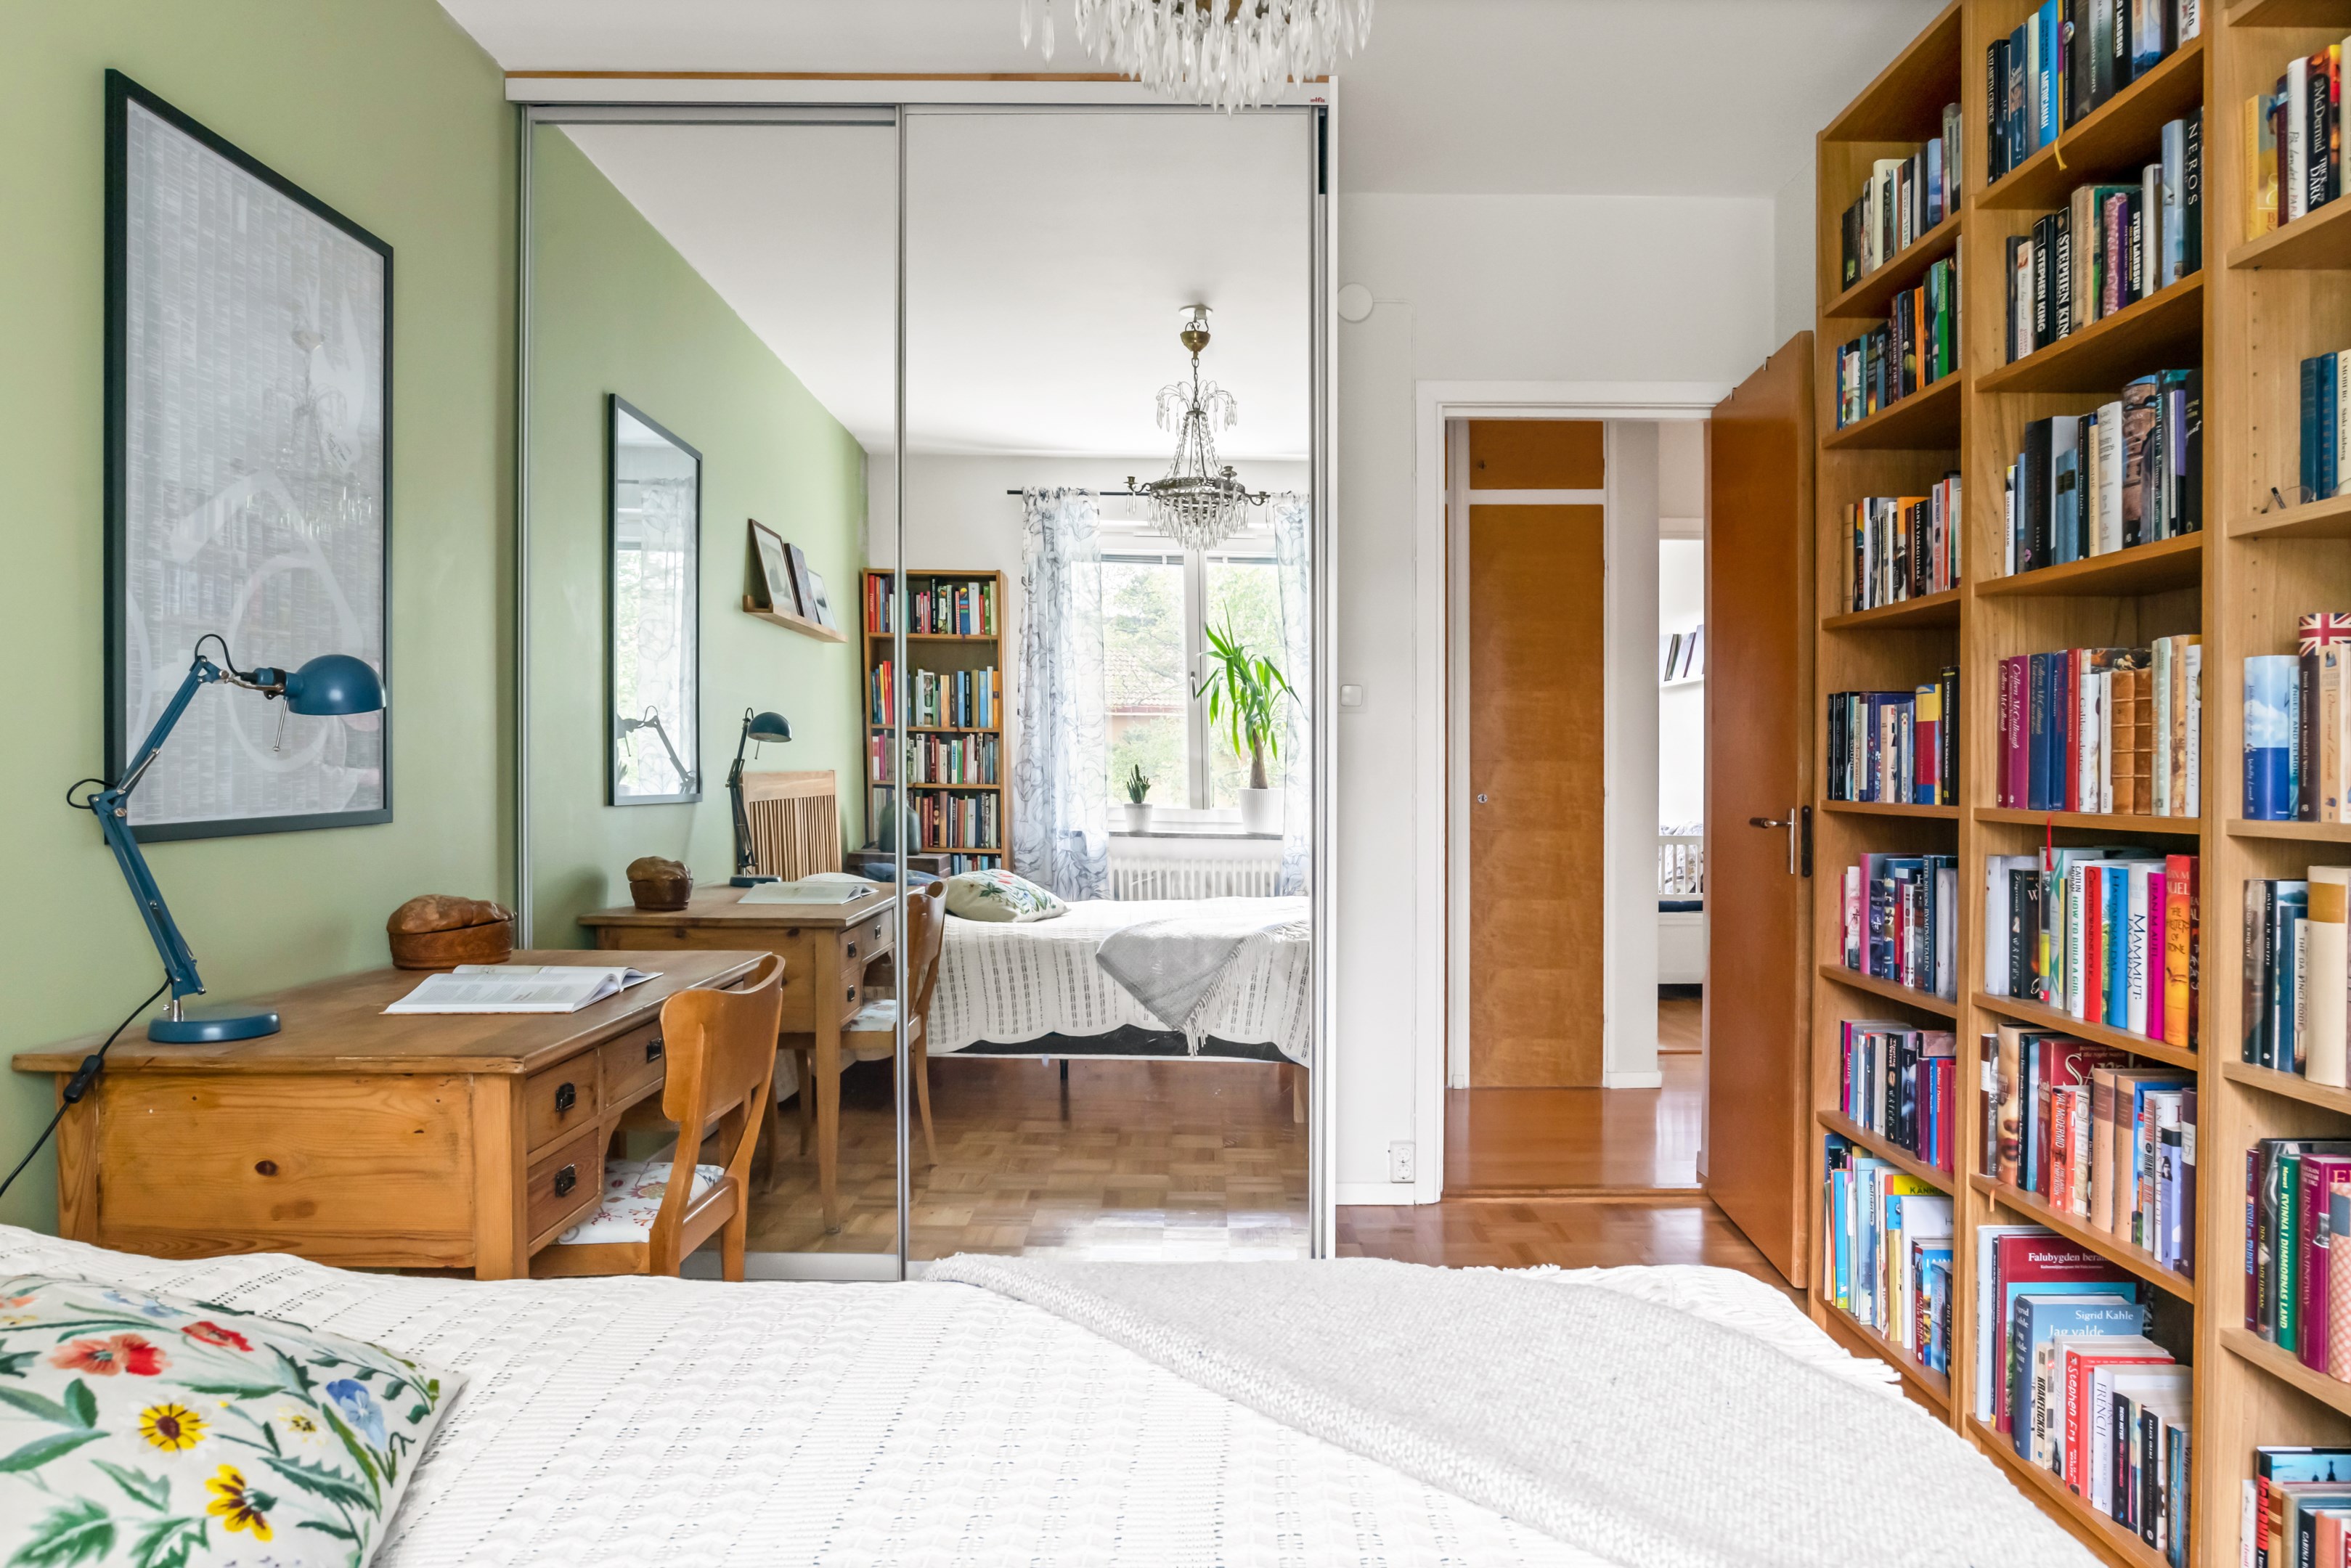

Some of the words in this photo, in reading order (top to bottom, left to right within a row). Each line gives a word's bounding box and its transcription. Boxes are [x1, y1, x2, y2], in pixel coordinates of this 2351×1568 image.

[2040, 70, 2049, 129] AMERICANAH
[2288, 131, 2300, 144] På
[2313, 90, 2326, 154] McDermid
[2318, 155, 2328, 184] TRICK
[2310, 166, 2322, 205] DARK
[2132, 211, 2141, 242] STIEG
[2037, 248, 2046, 301] STEPHEN
[2058, 234, 2070, 305] STEPHEN
[2132, 245, 2141, 292] LARSSON
[2037, 301, 2046, 333] KING
[2012, 663, 2021, 695] Colleen
[2036, 656, 2046, 686] Colleen
[2012, 698, 2021, 749] McCullough
[2036, 689, 2046, 735] McCullough
[2072, 922, 2079, 934] TO
[2151, 915, 2159, 927] M
[2297, 937, 2307, 953] THE
[2297, 957, 2307, 970] DA
[2297, 1002, 2307, 1026] CODE
[2055, 1093, 2066, 1106] VAL
[2143, 1097, 2154, 1116] PIPER
[2055, 1108, 2066, 1148] McDERMID
[2143, 1115, 2154, 1142] KERMAN
[2143, 1153, 2154, 1178] ORANGE
[2280, 1192, 2290, 1230] KVINNA
[2302, 1188, 2312, 1233] ERNEST
[2028, 1252, 2080, 1264] Falubygden
[2280, 1238, 2290, 1299] DIMMORNAS
[2302, 1236, 2312, 1307] HEMINGWAY
[2075, 1310, 2103, 1320] Sigrid
[2106, 1310, 2134, 1320] Kahle
[2280, 1302, 2290, 1329] LAND
[1947, 1327, 1952, 1337] OF
[2048, 1324, 2068, 1339] Jag
[2071, 1325, 2104, 1336] valde
[2067, 1365, 2079, 1417] Stephen
[2096, 1381, 2107, 1437] FRENCH
[2067, 1419, 2079, 1442] Fry
[2257, 1474, 2270, 1551] McDERMID
